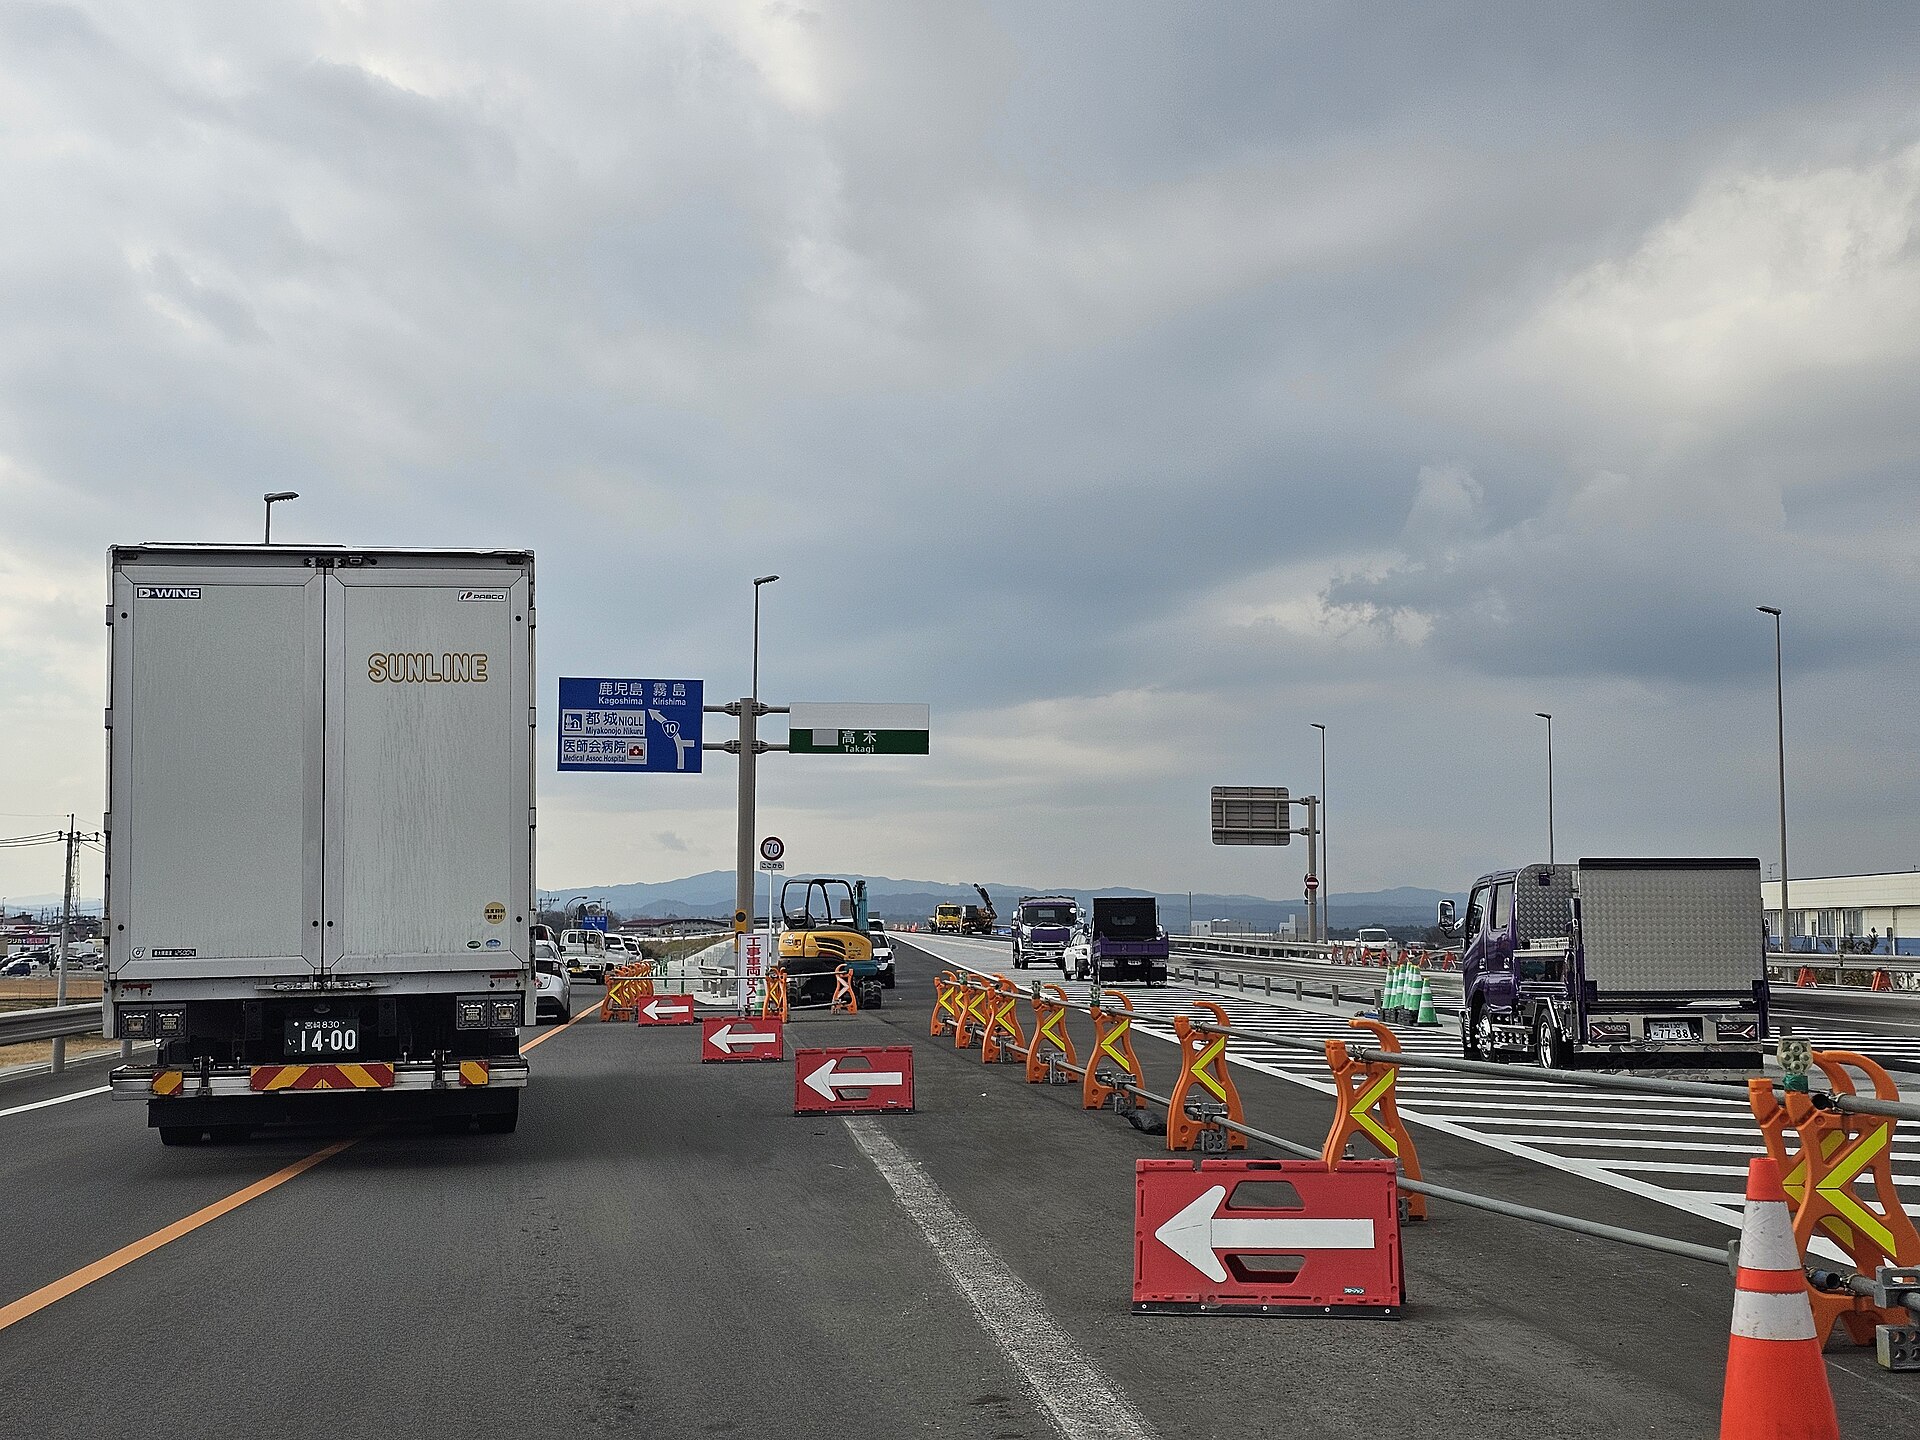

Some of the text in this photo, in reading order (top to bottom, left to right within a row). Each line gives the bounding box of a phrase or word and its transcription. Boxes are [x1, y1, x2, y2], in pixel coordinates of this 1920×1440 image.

[368, 652, 489, 683] SUNLINE
[598, 682, 686, 697] 鹿児島 霧島
[598, 696, 687, 706] Kagoshima Kirishima
[585, 726, 622, 736] Miyakonojo
[665, 725, 677, 733] 10
[842, 730, 877, 744] 高木
[563, 739, 626, 754] 医師会病院
[844, 745, 875, 753] Takagi
[563, 754, 585, 762] Medical
[603, 754, 626, 763] Hospital
[766, 843, 779, 854] 70
[1658, 1029, 1689, 1038] 77-88
[301, 1029, 357, 1052] 14-00
